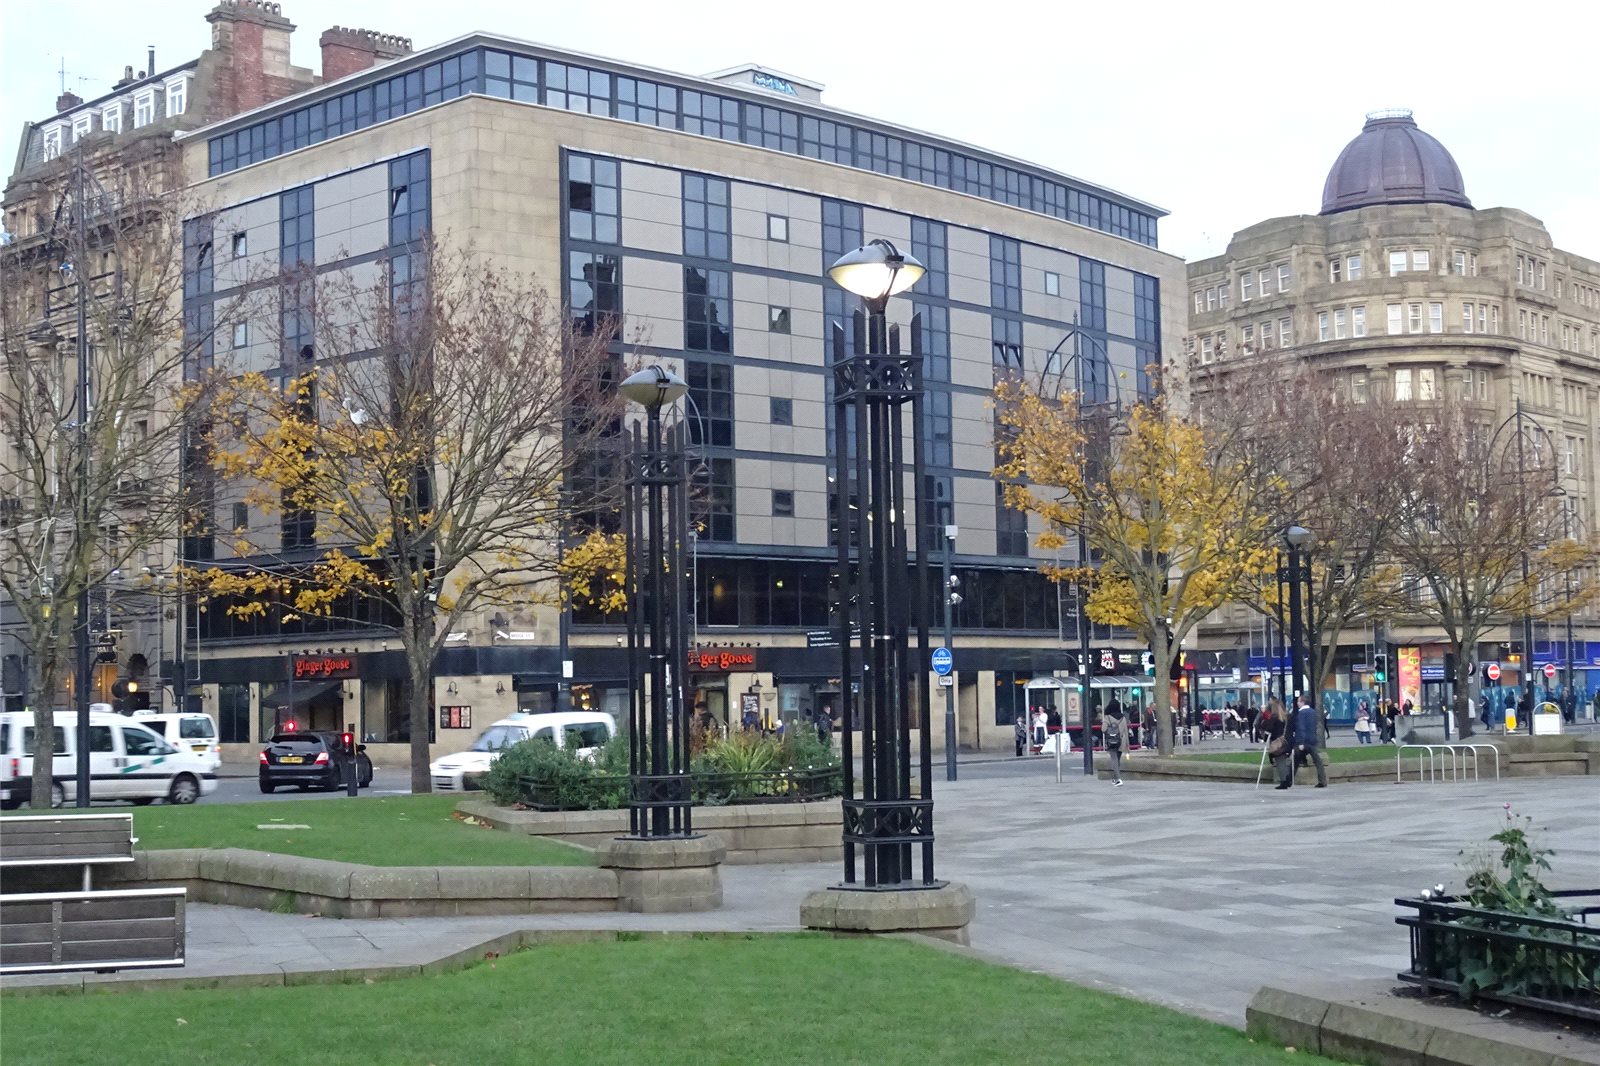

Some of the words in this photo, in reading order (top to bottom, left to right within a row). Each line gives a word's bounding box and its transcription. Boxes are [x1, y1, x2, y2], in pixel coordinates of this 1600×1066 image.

[296, 659, 323, 677] ginger
[324, 658, 349, 676] goose
[720, 652, 753, 669] goose
